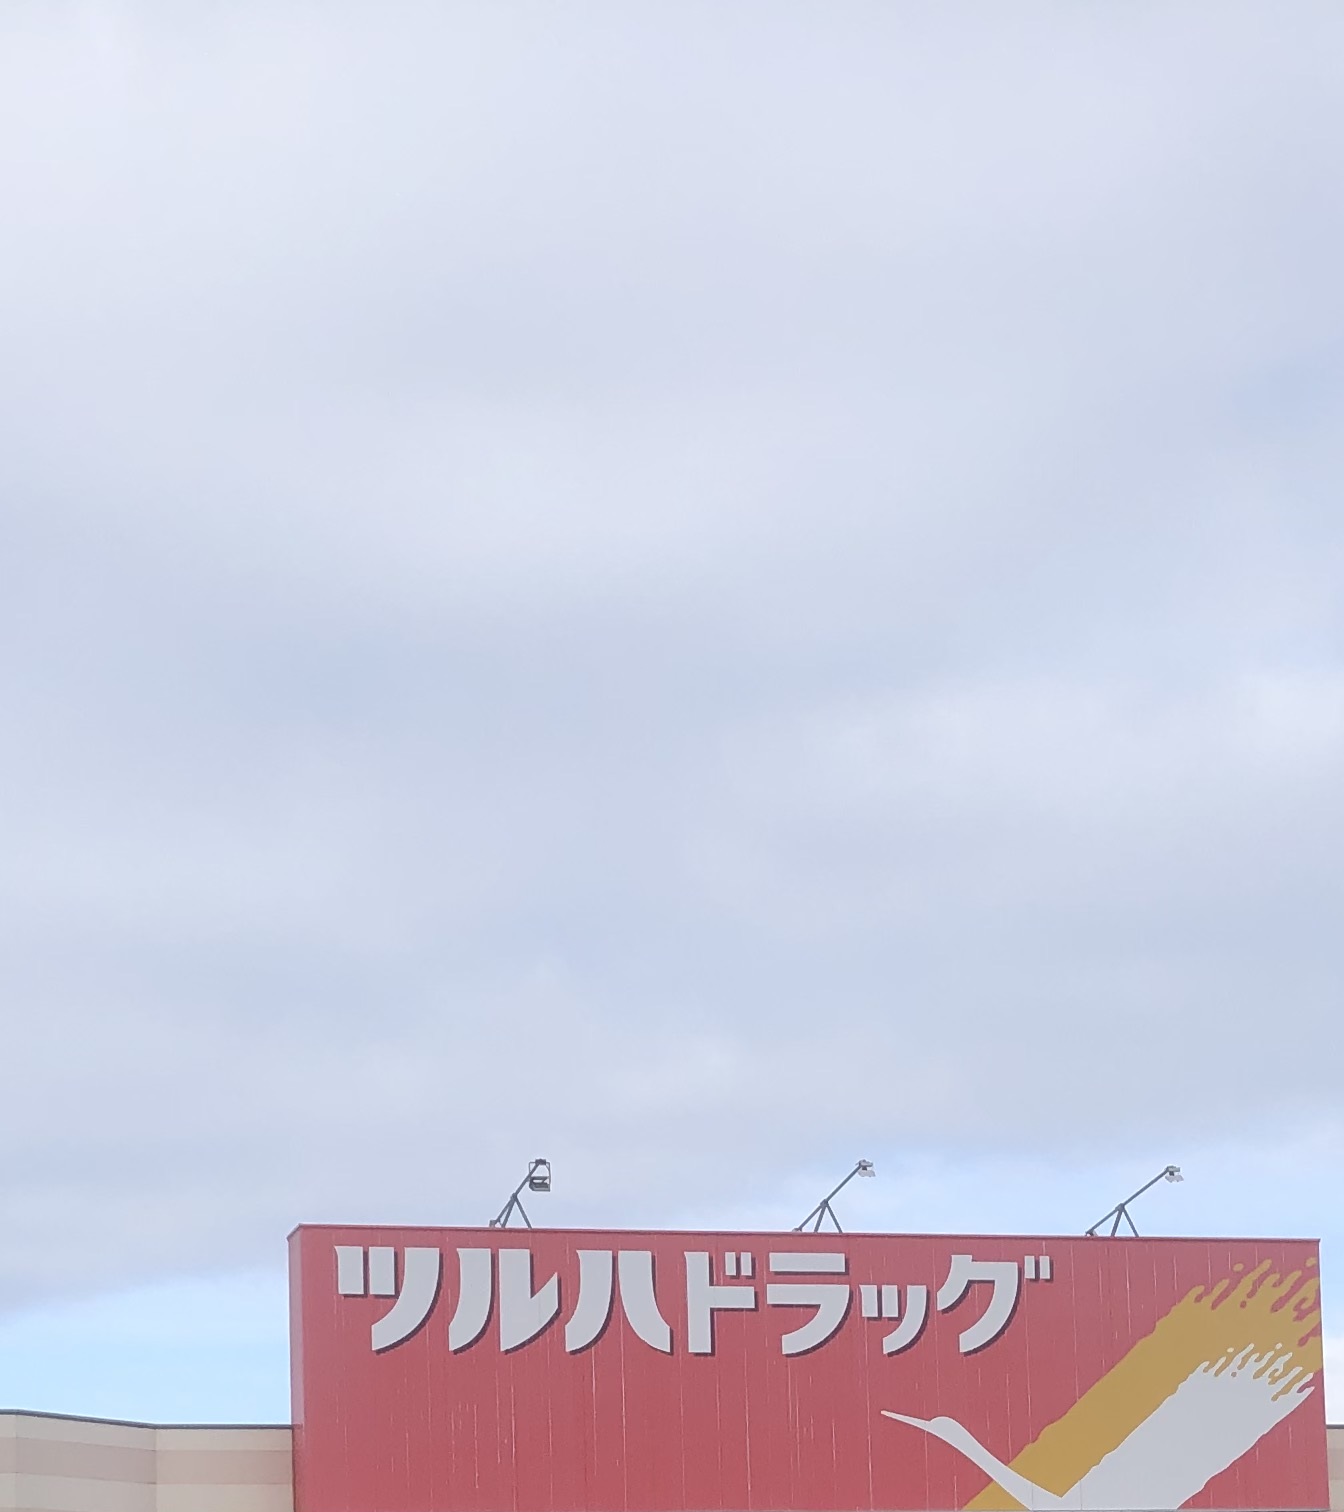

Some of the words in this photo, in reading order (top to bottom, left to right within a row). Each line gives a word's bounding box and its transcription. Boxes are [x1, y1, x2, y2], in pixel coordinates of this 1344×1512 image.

[334, 1244, 1054, 1357] ツルハドラッグ
